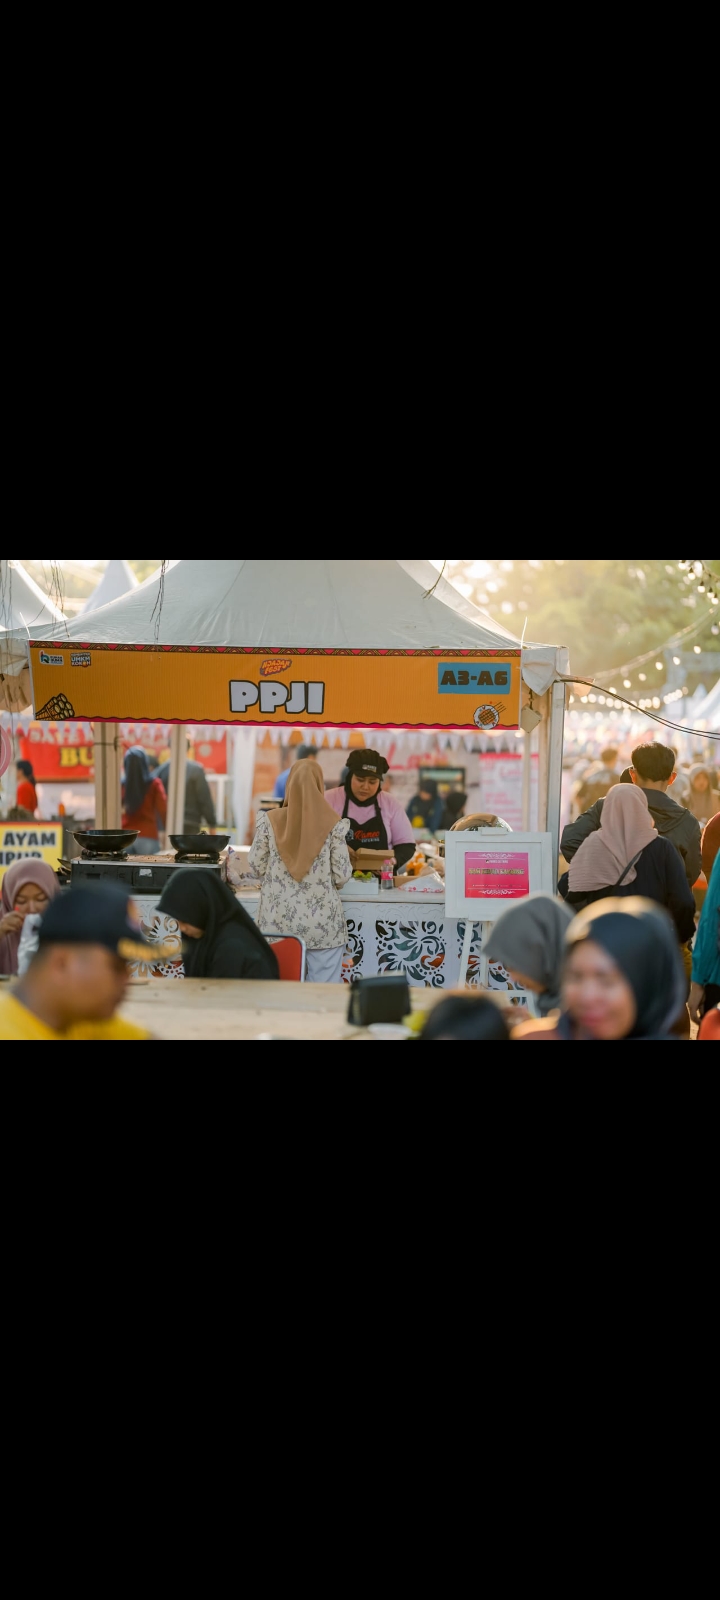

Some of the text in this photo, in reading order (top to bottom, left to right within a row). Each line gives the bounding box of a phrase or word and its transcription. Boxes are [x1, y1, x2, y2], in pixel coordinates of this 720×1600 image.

[264, 665, 282, 675] FEST
[440, 670, 508, 686] A3-A6
[229, 680, 325, 714] PPJI
[4, 832, 56, 846] AYAM
